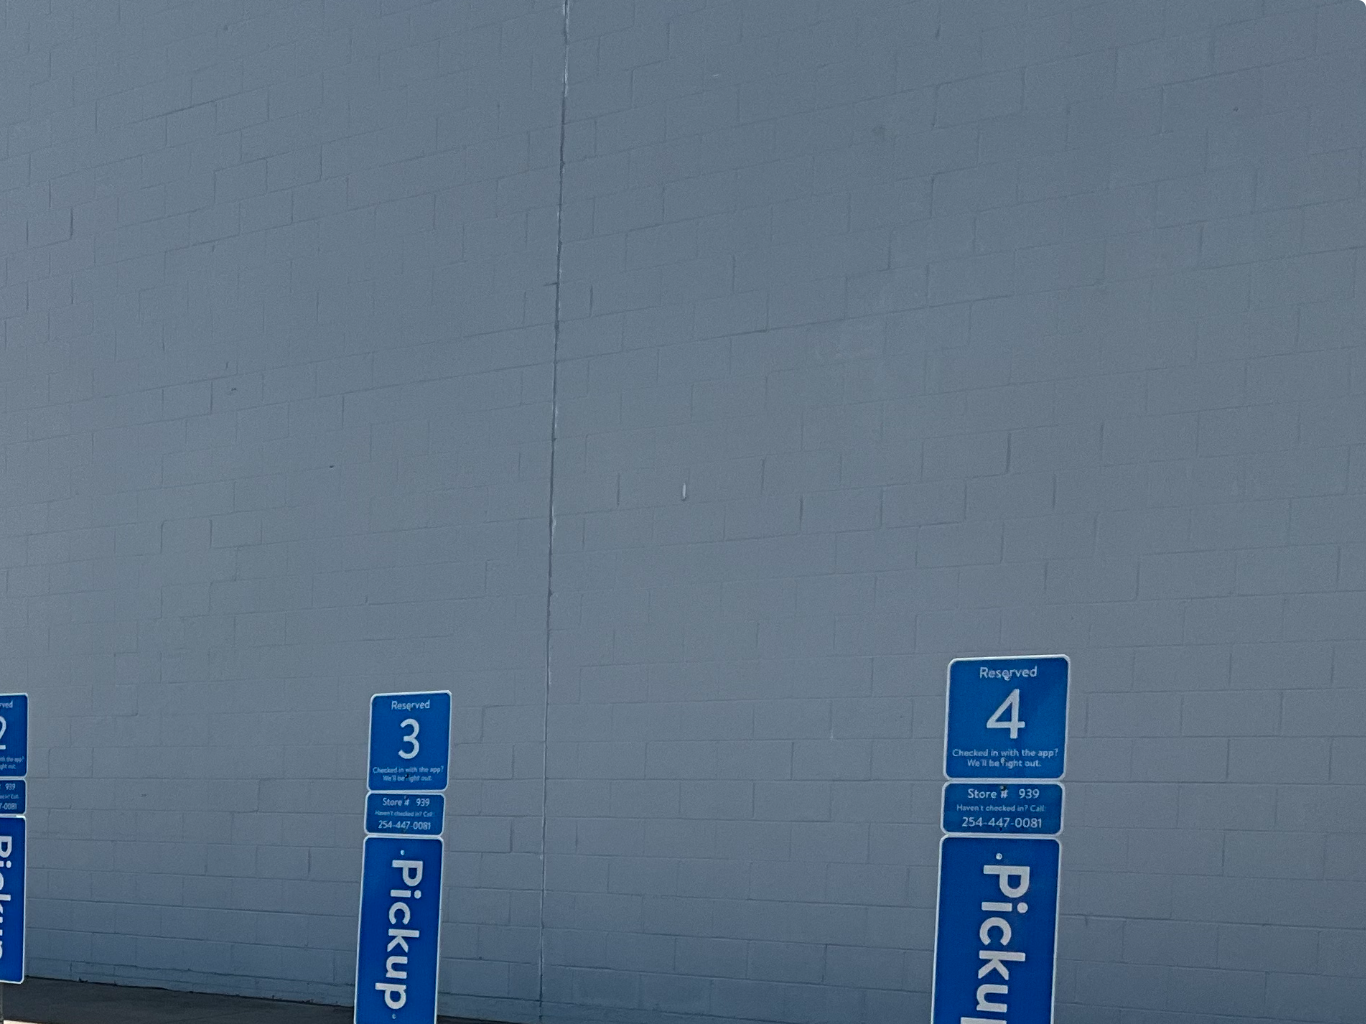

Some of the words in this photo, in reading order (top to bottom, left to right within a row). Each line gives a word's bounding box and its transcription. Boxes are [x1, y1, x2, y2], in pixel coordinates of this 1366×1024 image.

[979, 666, 1038, 679] Reserved
[391, 700, 431, 712] Reserved
[986, 688, 1025, 739] 4
[398, 718, 420, 760] 3
[952, 749, 988, 757] Checked
[990, 749, 998, 757] in
[1000, 749, 1019, 757] with
[1022, 748, 1036, 757] the
[1038, 748, 1059, 758] app?
[989, 759, 1000, 767] be
[967, 788, 997, 799] Store
[1000, 789, 1008, 798] #
[1018, 788, 1040, 799] 939
[382, 797, 402, 806] Store
[416, 798, 430, 807] 939
[985, 804, 1015, 812] checked
[378, 820, 432, 830] 254-447-0081
[962, 816, 1042, 828] 254-447-0081
[375, 860, 423, 1010] Pickup
